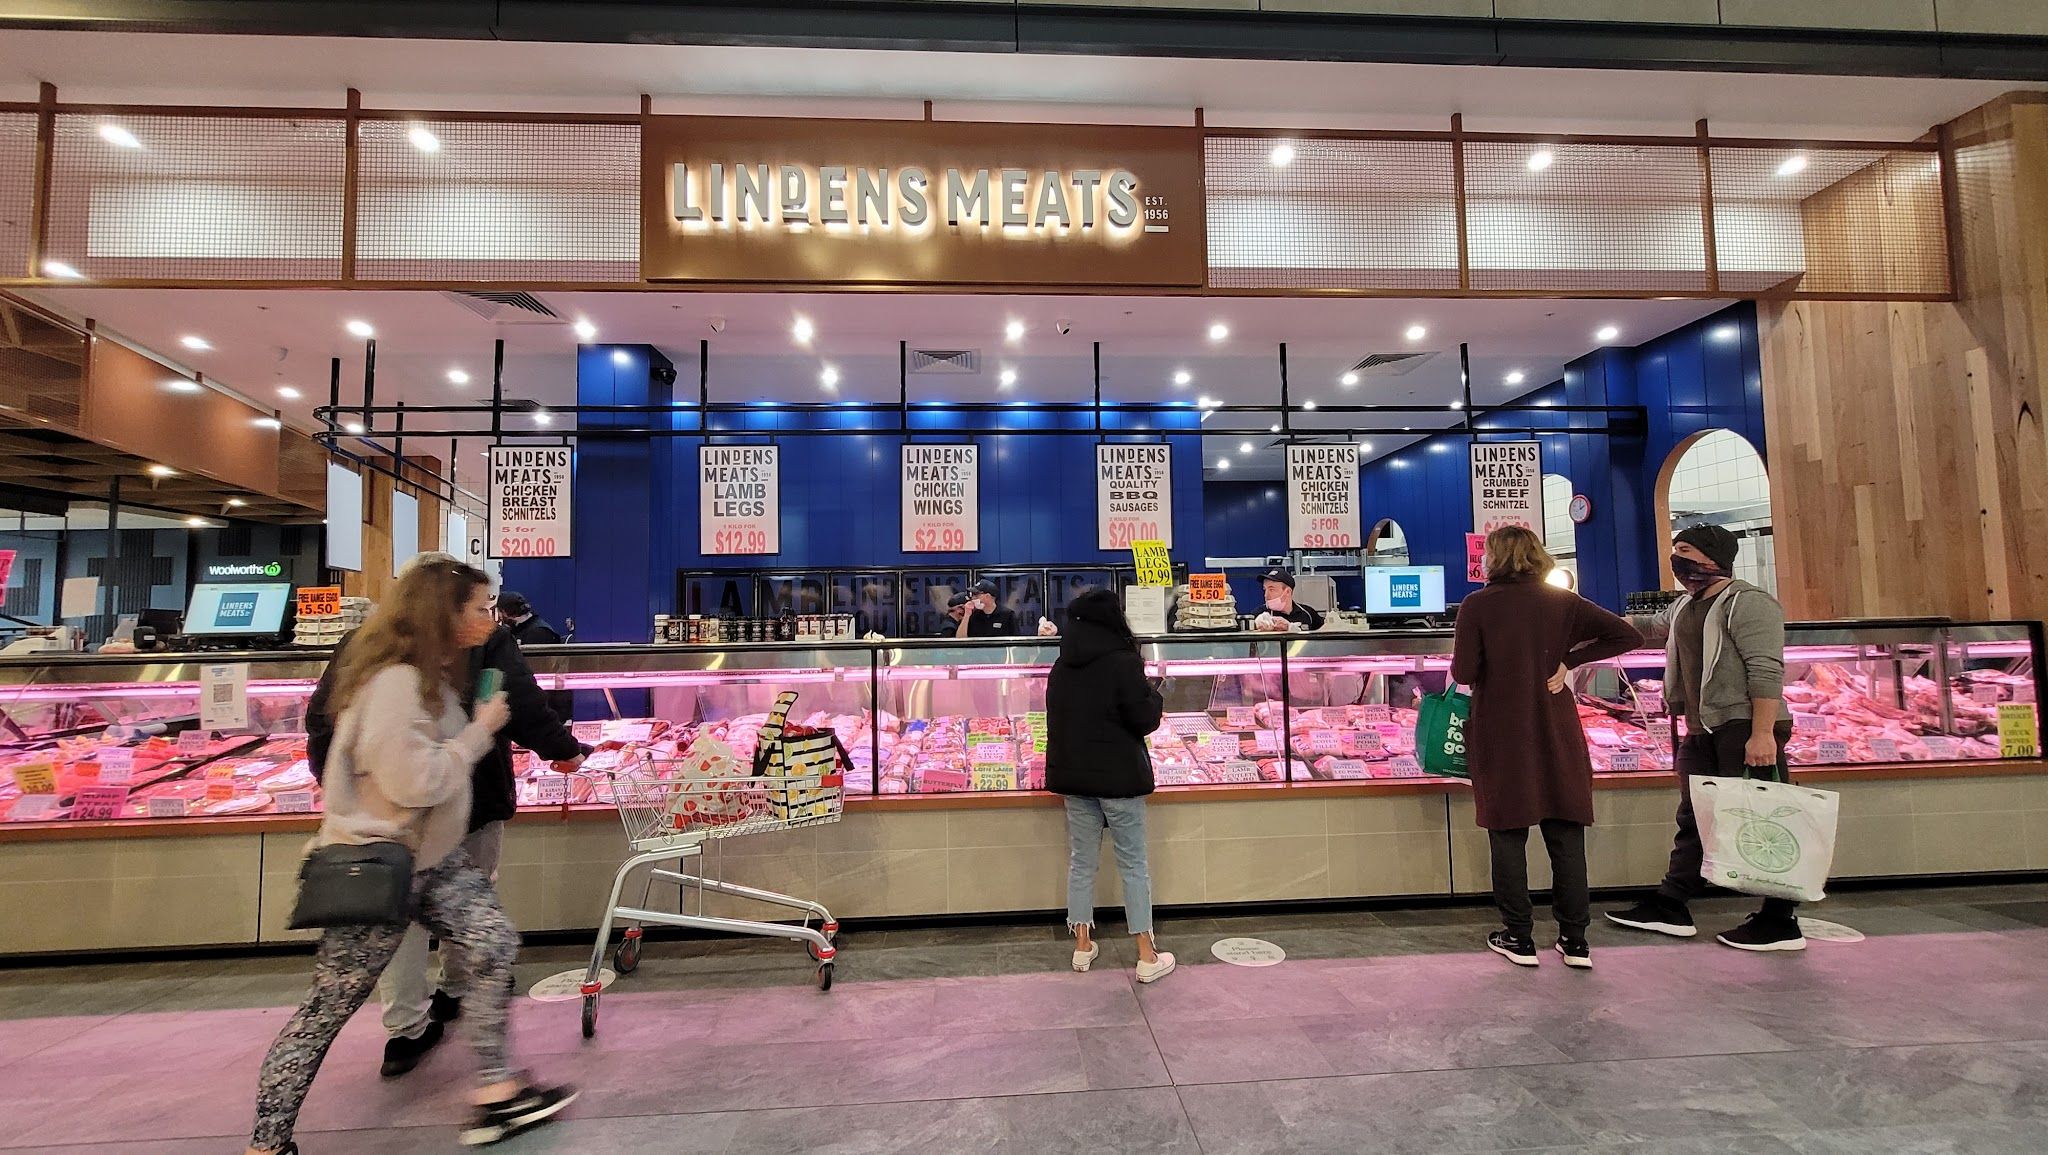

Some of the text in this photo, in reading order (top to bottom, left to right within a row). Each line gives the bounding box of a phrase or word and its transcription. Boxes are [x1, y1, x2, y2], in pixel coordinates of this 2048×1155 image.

[673, 161, 1138, 230] LINDENS MEATS
[1145, 196, 1168, 206] EST.
[1144, 209, 1168, 220] 1956
[495, 451, 567, 467] LINDENS
[704, 450, 773, 466] LINDENS
[906, 449, 973, 464] LINDENS
[1101, 448, 1166, 463] LINDENS
[1292, 448, 1355, 464] LINDENS
[1474, 447, 1536, 462] LINDENS
[495, 469, 551, 485] MEATS
[704, 467, 758, 483] MEATS
[906, 466, 959, 481] MEATS
[1101, 465, 1152, 480] MEATS
[1292, 465, 1342, 480] MEATS
[1475, 464, 1523, 479] MEATS
[503, 485, 557, 496] CHICKEN
[914, 483, 964, 497] CHICKEN
[1109, 480, 1158, 489] QUALITY
[1301, 481, 1349, 491] CHICKEN
[1482, 479, 1529, 487] CRUMBED
[714, 483, 767, 499] LAMB
[1109, 491, 1158, 500] BBQ
[1301, 491, 1349, 502] THIGH
[1483, 488, 1529, 498] BEEF
[502, 497, 556, 507] BREAST
[713, 501, 765, 517] LEGS
[913, 500, 963, 515] WINGS
[1109, 502, 1159, 512] SAUSAGES
[1300, 502, 1349, 515] SCHNITZELS
[1482, 500, 1529, 509] SCHNITZEL
[502, 508, 556, 521] SCHNITZELS
[1312, 518, 1339, 530] 5 FOR
[715, 530, 766, 554] $12.99
[915, 528, 964, 551] $2.99
[1109, 521, 1158, 548] $2000
[1304, 533, 1350, 548] $9.00
[470, 538, 480, 555] C
[501, 537, 555, 556] $20.00
[1135, 546, 1166, 557] LAMB
[1137, 557, 1169, 568] LEGS
[1138, 569, 1170, 584] $12.99
[219, 609, 245, 617] MEATS
[221, 602, 254, 610] LINDENS
[1447, 727, 1465, 743] fo
[1443, 741, 1466, 755] go
[974, 779, 1009, 790] $22.99
